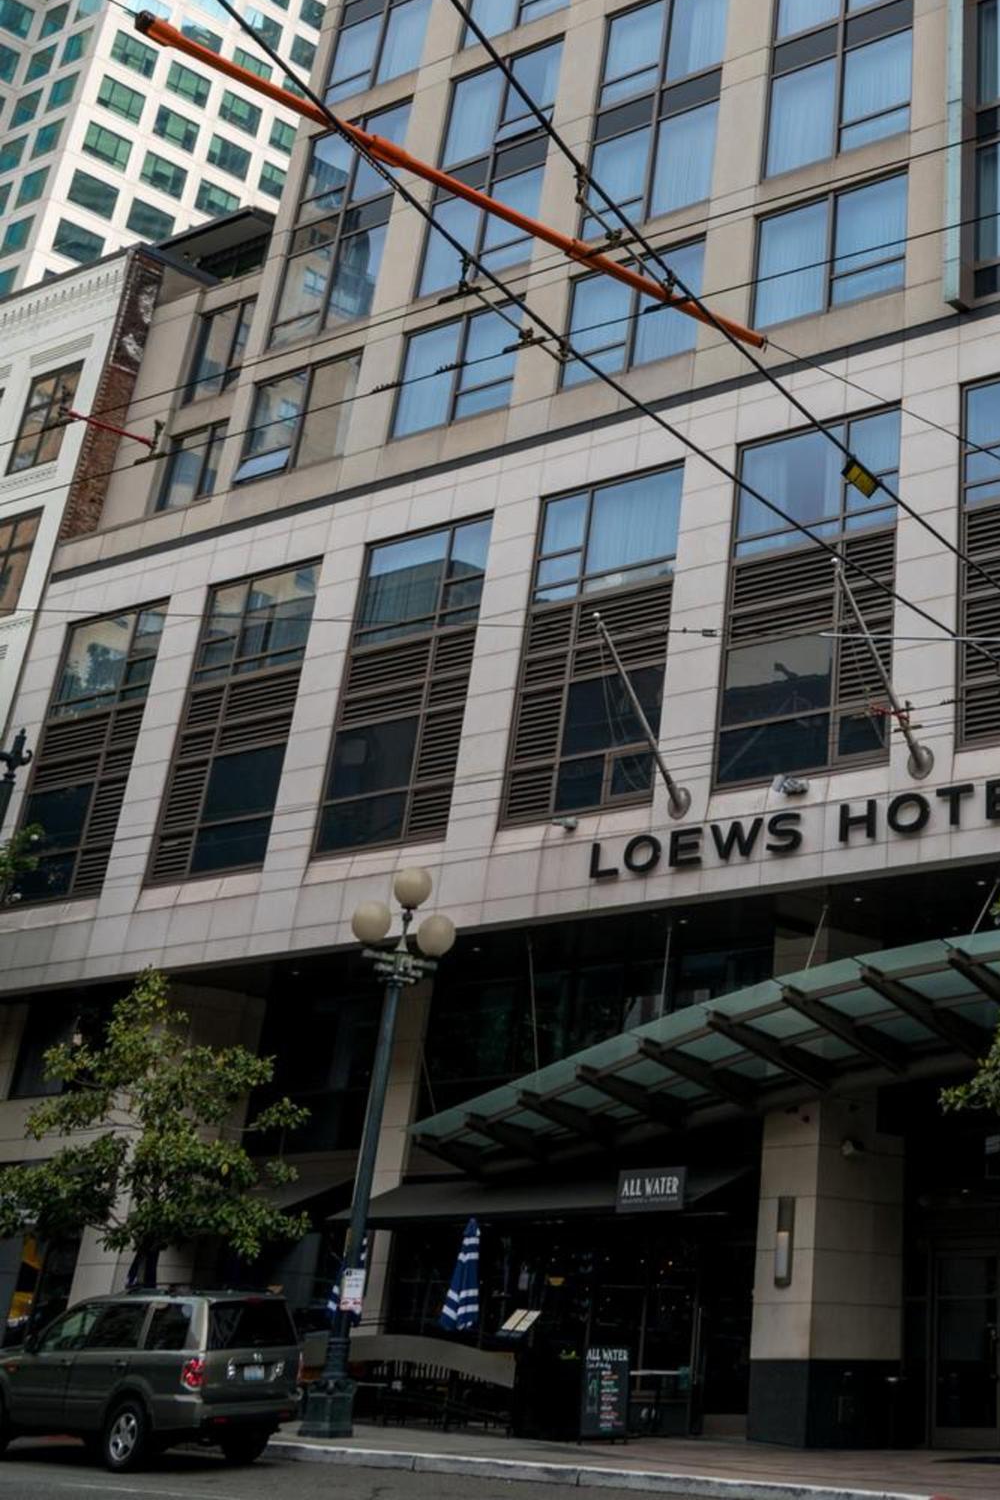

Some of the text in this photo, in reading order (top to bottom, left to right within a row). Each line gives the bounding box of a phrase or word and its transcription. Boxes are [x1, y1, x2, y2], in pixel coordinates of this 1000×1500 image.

[589, 812, 804, 879] LOEWS
[621, 1176, 680, 1197] ALL WATER
[586, 1348, 629, 1361] ALL WATER
